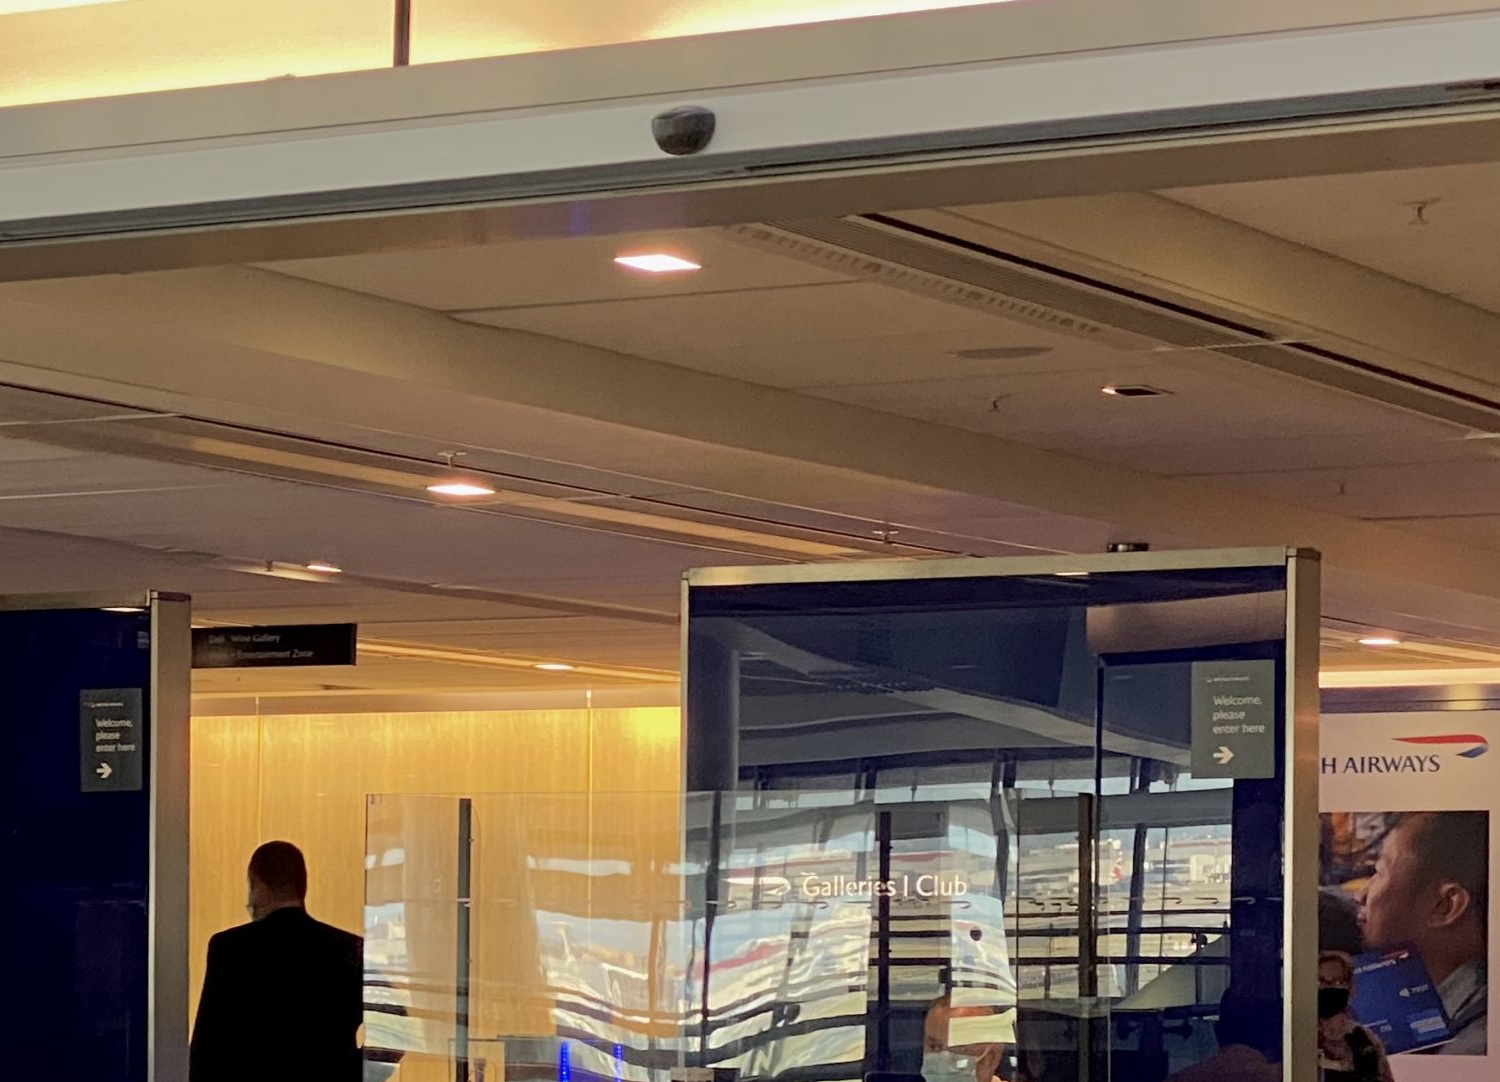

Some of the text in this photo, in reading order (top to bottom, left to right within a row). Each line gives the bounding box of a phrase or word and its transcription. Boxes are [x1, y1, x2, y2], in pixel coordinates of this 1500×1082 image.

[1212, 710, 1246, 722] please
[1212, 723, 1266, 734] enter here
[95, 731, 121, 742] please
[1342, 754, 1441, 774] AIRWAYS
[802, 874, 968, 897] Galleries Club
